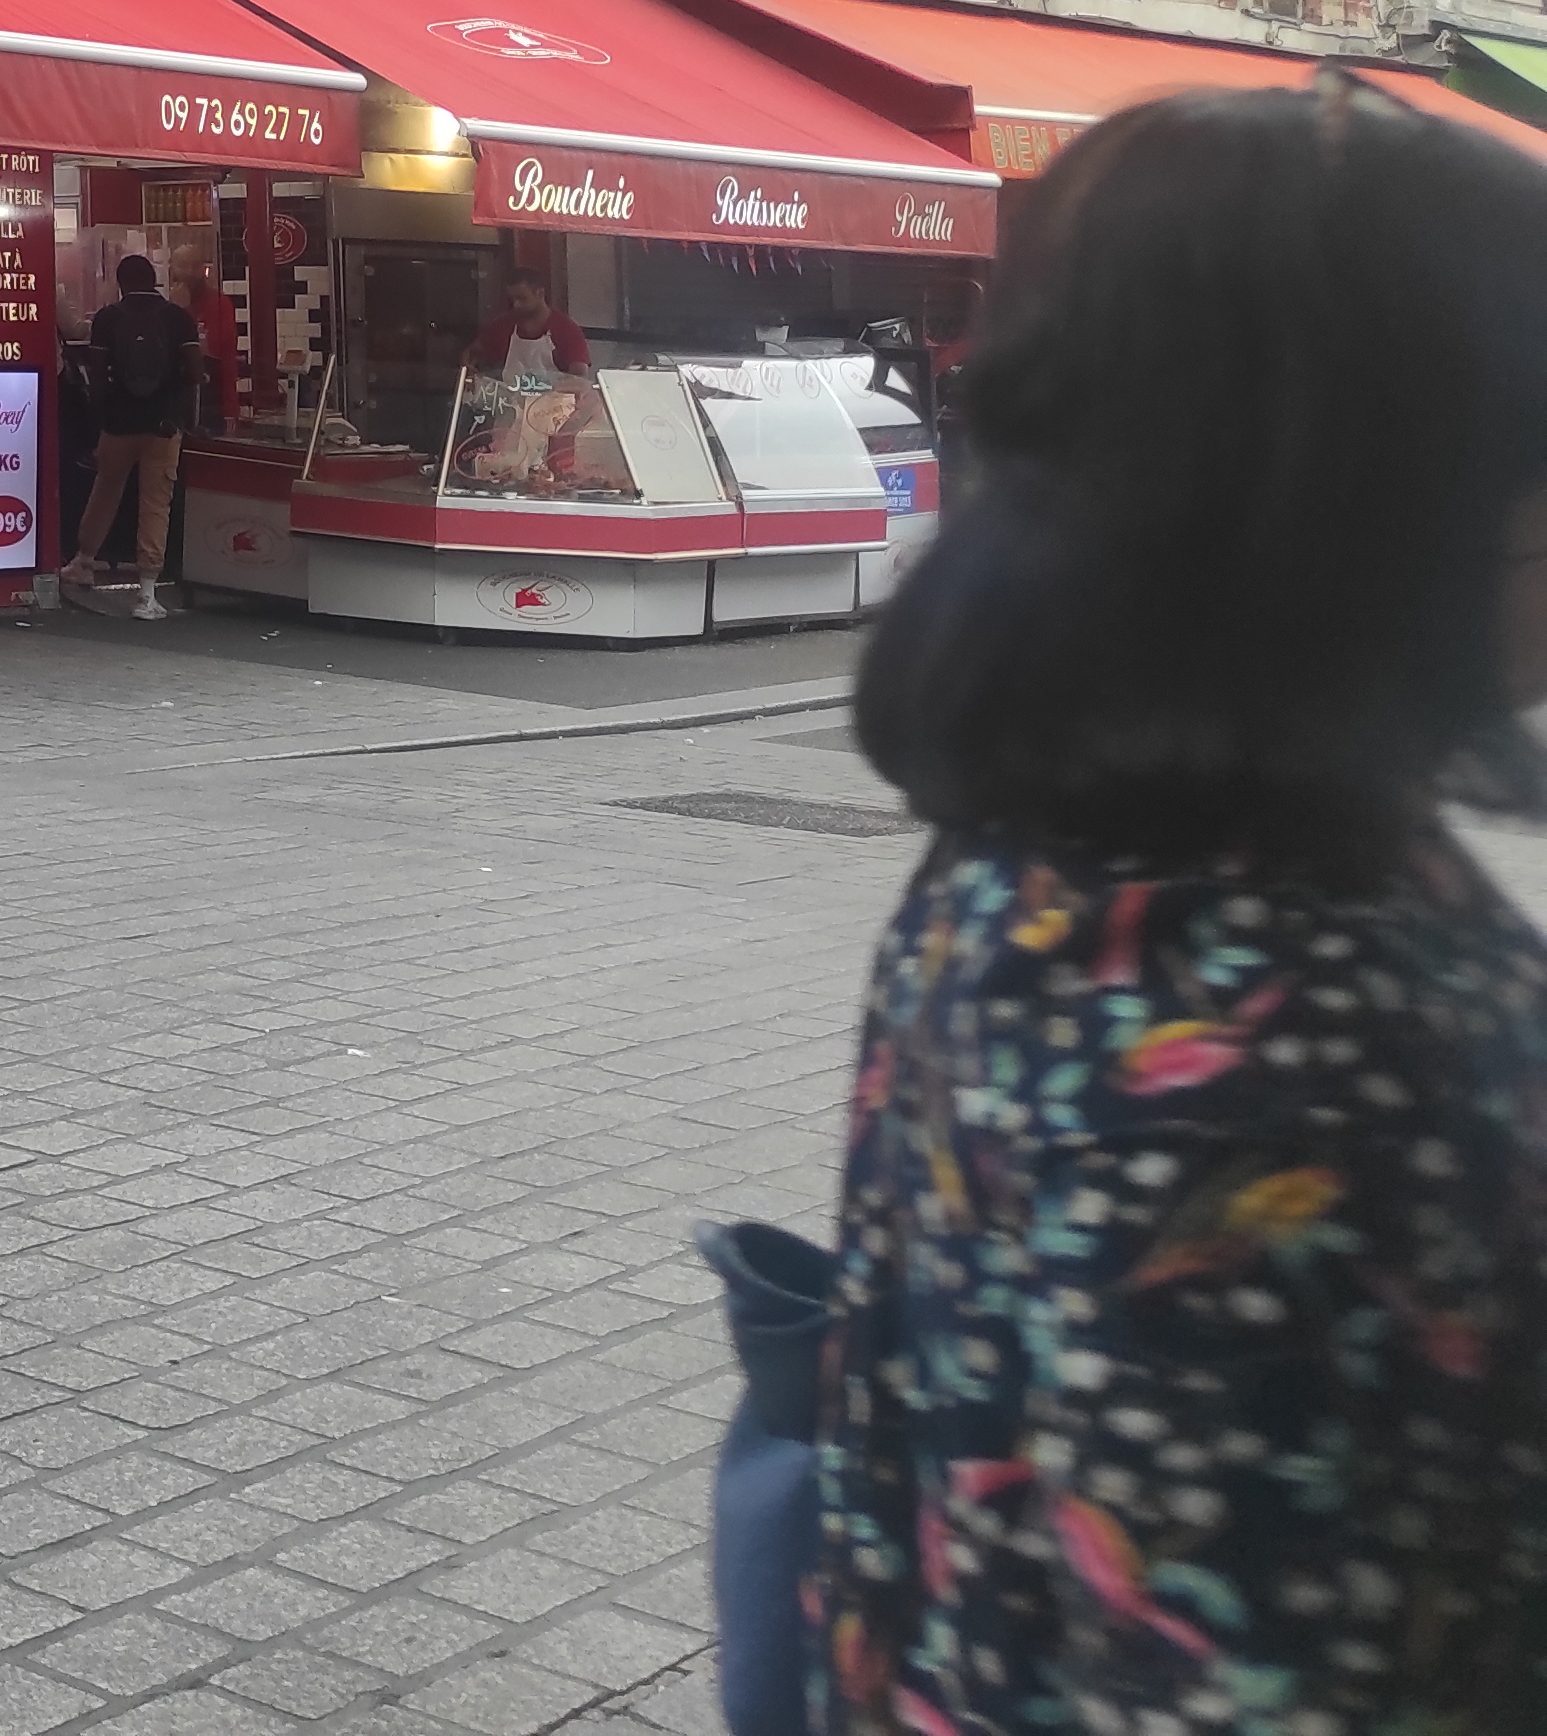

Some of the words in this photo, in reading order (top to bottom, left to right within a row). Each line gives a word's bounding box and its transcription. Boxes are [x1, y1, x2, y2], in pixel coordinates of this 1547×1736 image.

[161, 94, 189, 132] 09
[195, 98, 224, 134] 73
[230, 99, 257, 137] 69
[264, 105, 289, 141] 27
[297, 109, 323, 145] 76
[11, 151, 40, 173] RÔTI
[988, 123, 1050, 171] BIEN
[508, 158, 635, 221] Boucherie
[712, 175, 808, 230] Rotisserie
[891, 191, 954, 243] Paëlla
[13, 248, 22, 269] À
